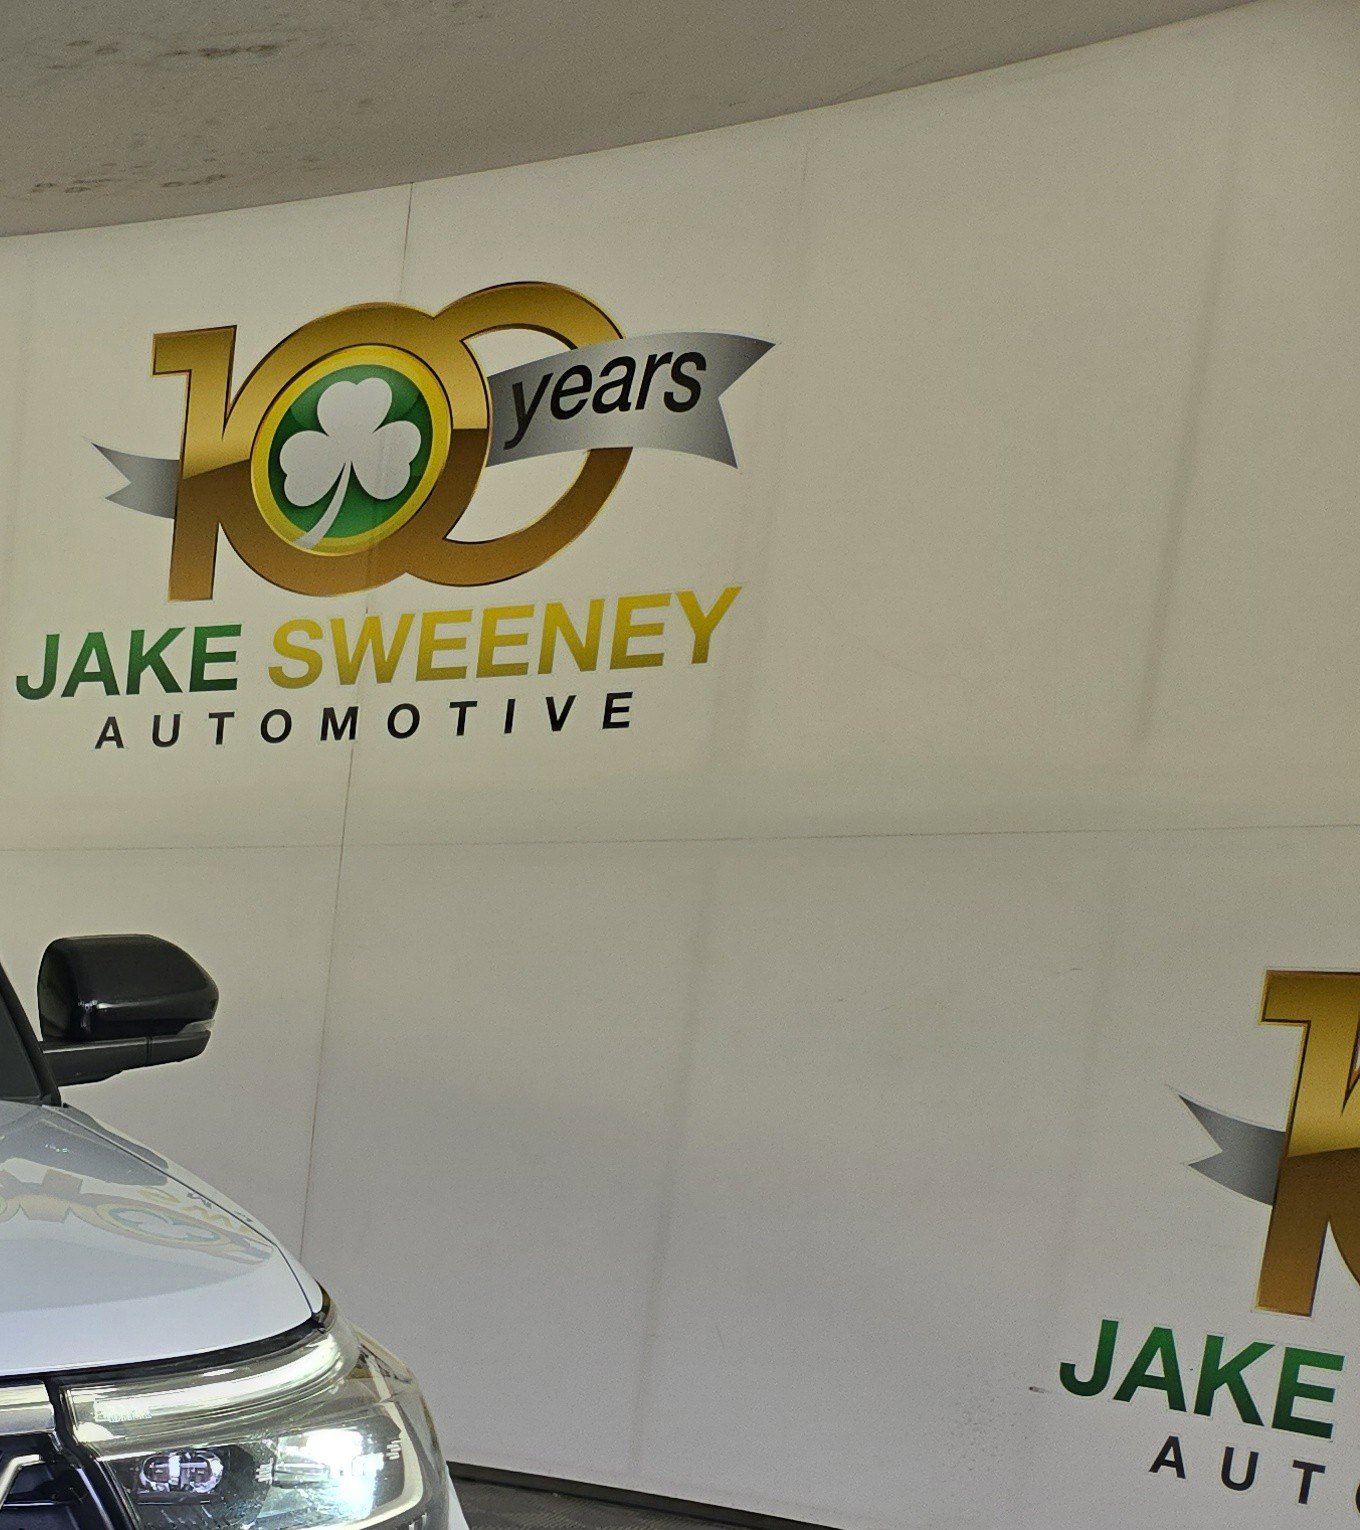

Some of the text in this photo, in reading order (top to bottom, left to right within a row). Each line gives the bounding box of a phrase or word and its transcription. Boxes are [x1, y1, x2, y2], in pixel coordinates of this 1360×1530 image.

[503, 346, 708, 451] years
[15, 586, 743, 701] JAKE SWEENEY
[94, 691, 635, 751] AUTOMOTIVE
[1059, 1318, 1346, 1440] JAKE
[1148, 1435, 1360, 1513] AUT
